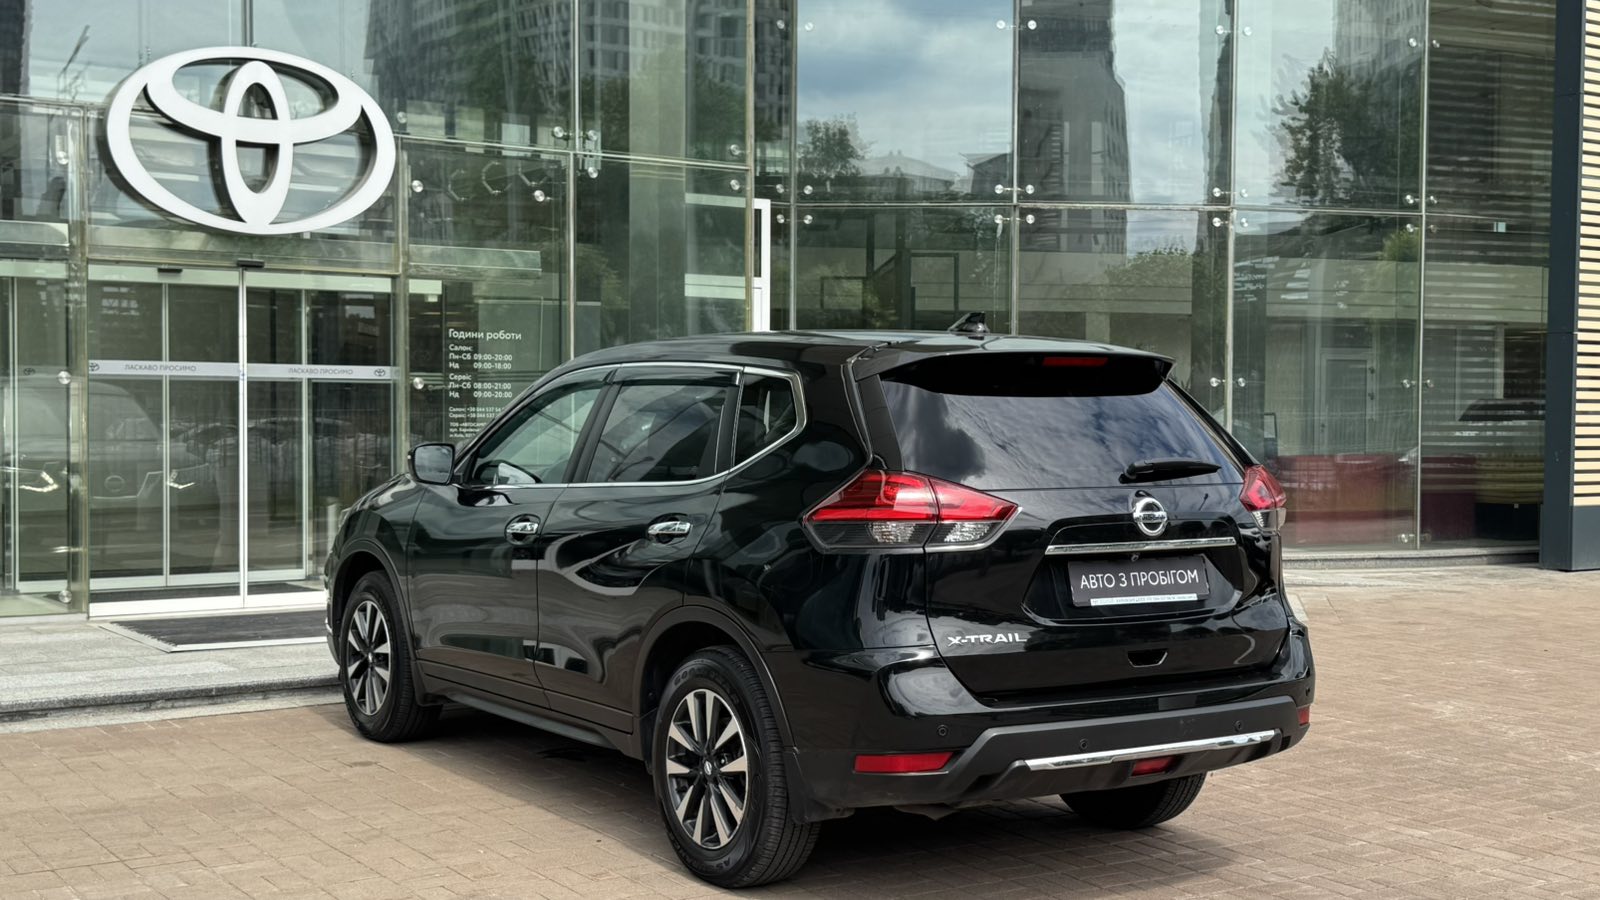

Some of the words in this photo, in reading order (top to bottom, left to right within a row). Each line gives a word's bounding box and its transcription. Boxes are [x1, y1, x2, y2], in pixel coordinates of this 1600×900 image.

[448, 328, 484, 340] Години
[486, 330, 522, 341] роботи
[448, 343, 473, 352] Салон:
[448, 353, 472, 361] Пн-Сб
[473, 353, 513, 361] 09:00-20:00
[159, 364, 197, 372] ПРОСИМО
[448, 361, 460, 369] Нд
[473, 362, 512, 370] 09:00-18:00
[288, 367, 319, 375] ЛАСКАВО
[319, 368, 354, 376] ПРОСИМО
[473, 382, 512, 390] 08:00-21:00
[448, 390, 460, 398] Нд
[473, 390, 513, 399] 09:00-20:00
[1080, 573, 1116, 590] АВТО
[1130, 568, 1199, 587] ПРОБІГОМ
[947, 632, 1028, 647] X-TRAIL
